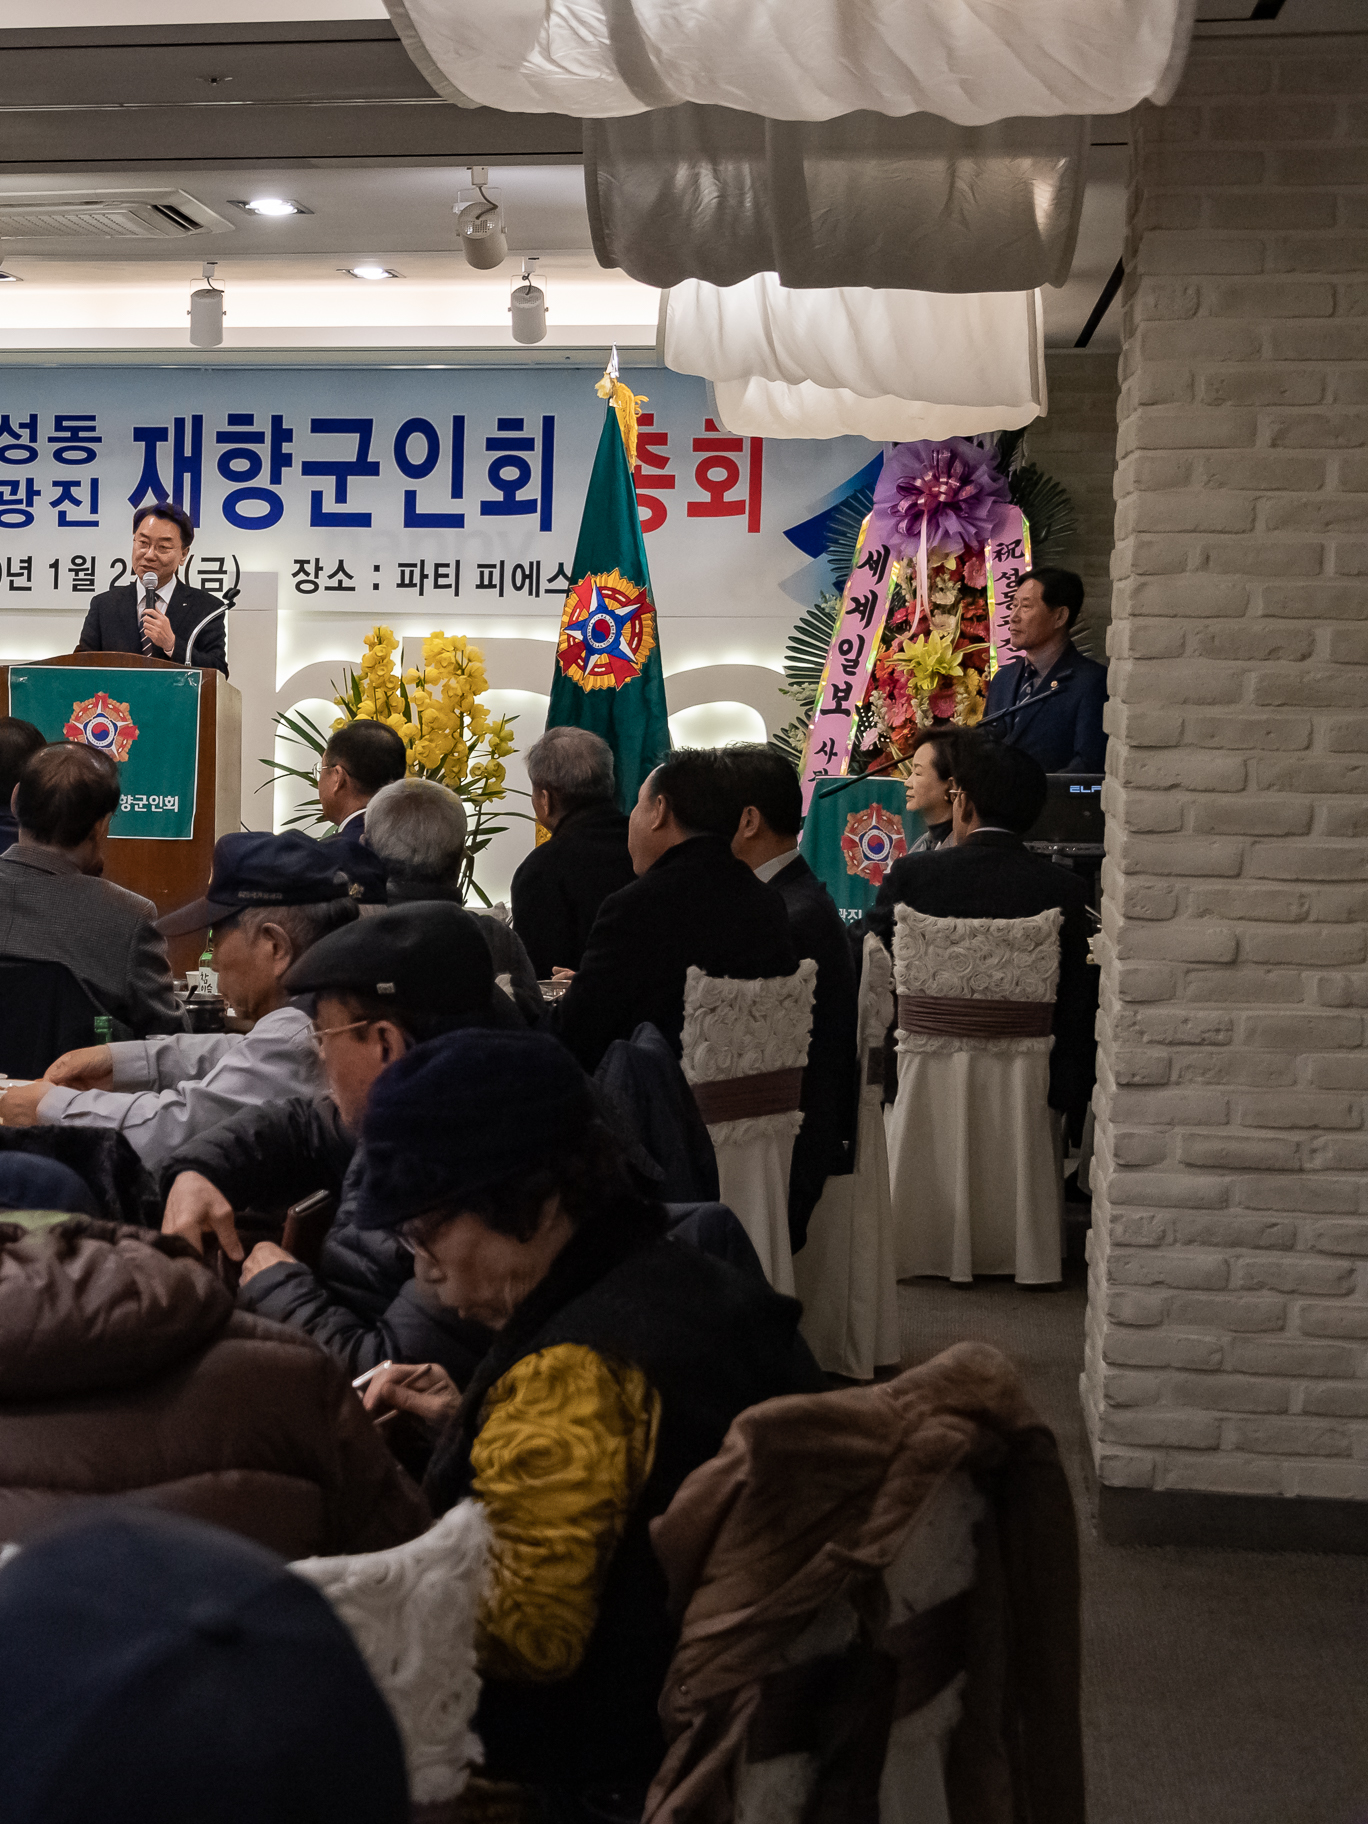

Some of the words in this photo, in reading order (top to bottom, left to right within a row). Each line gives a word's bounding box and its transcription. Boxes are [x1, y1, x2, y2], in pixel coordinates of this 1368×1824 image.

[127, 413, 556, 532] 재향군인회
[992, 541, 1025, 563] 祝
[48, 554, 97, 592] 1월
[291, 557, 356, 594] 장소
[396, 558, 461, 598] 파티
[820, 543, 891, 718] 세계일보
[120, 794, 179, 813] 향군인회
